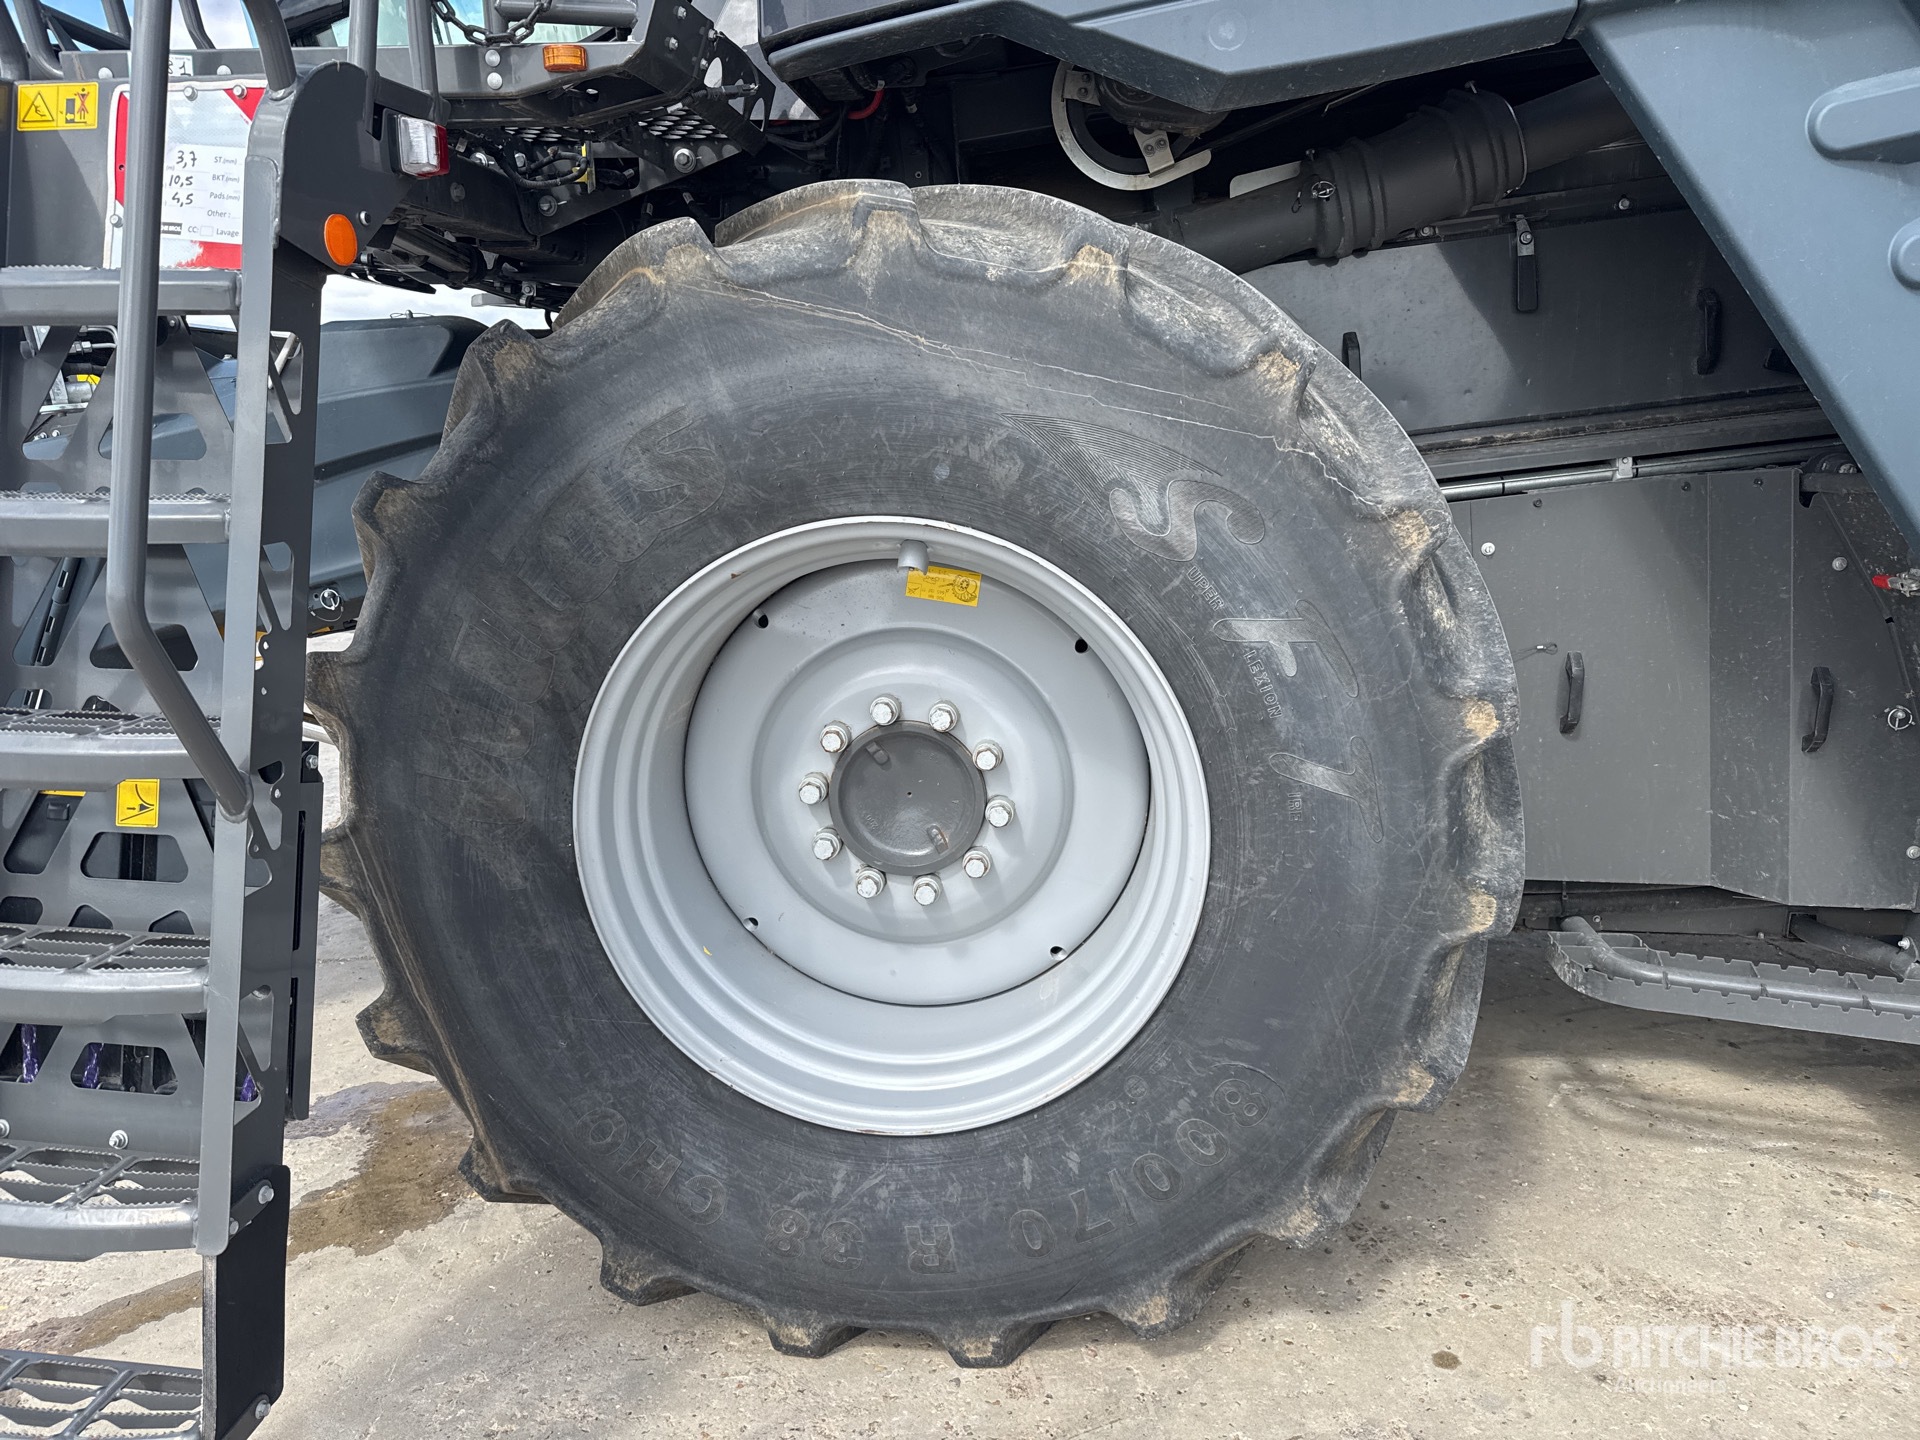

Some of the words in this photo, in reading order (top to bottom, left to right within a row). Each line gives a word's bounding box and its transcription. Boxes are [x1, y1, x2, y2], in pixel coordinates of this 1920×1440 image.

[176, 150, 197, 168] 3,7
[169, 174, 193, 187] 10,5
[172, 192, 194, 207] 4,5
[207, 209, 227, 217] Other
[216, 228, 239, 237] Lavage
